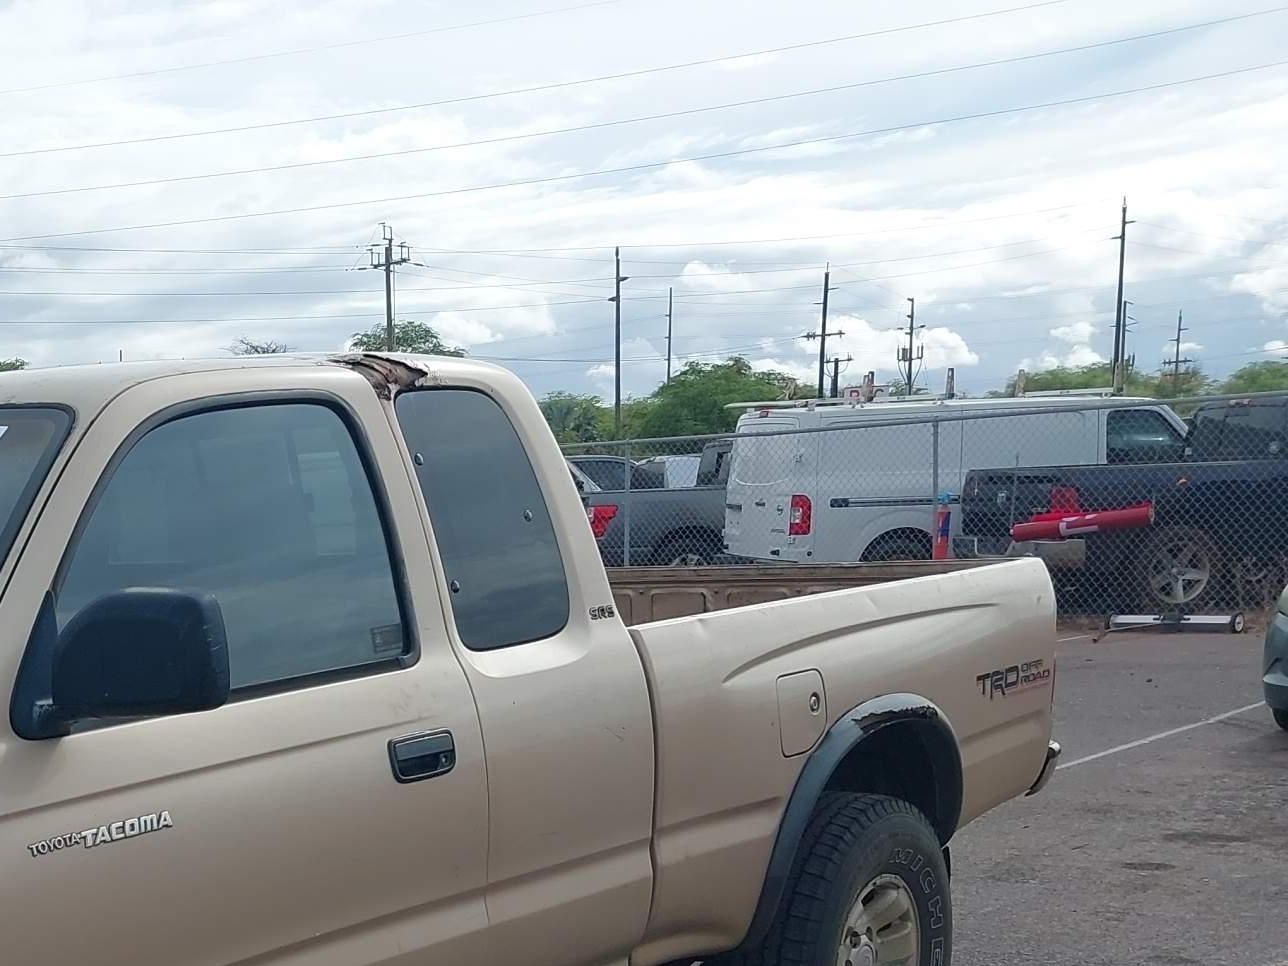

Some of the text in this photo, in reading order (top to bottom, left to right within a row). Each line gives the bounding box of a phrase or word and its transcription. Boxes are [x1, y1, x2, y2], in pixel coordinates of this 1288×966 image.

[1020, 658, 1043, 673] OFF
[1020, 669, 1050, 685] ROAD
[976, 665, 1019, 700] TRD
[29, 811, 173, 857] TOYOTA TACOMA
